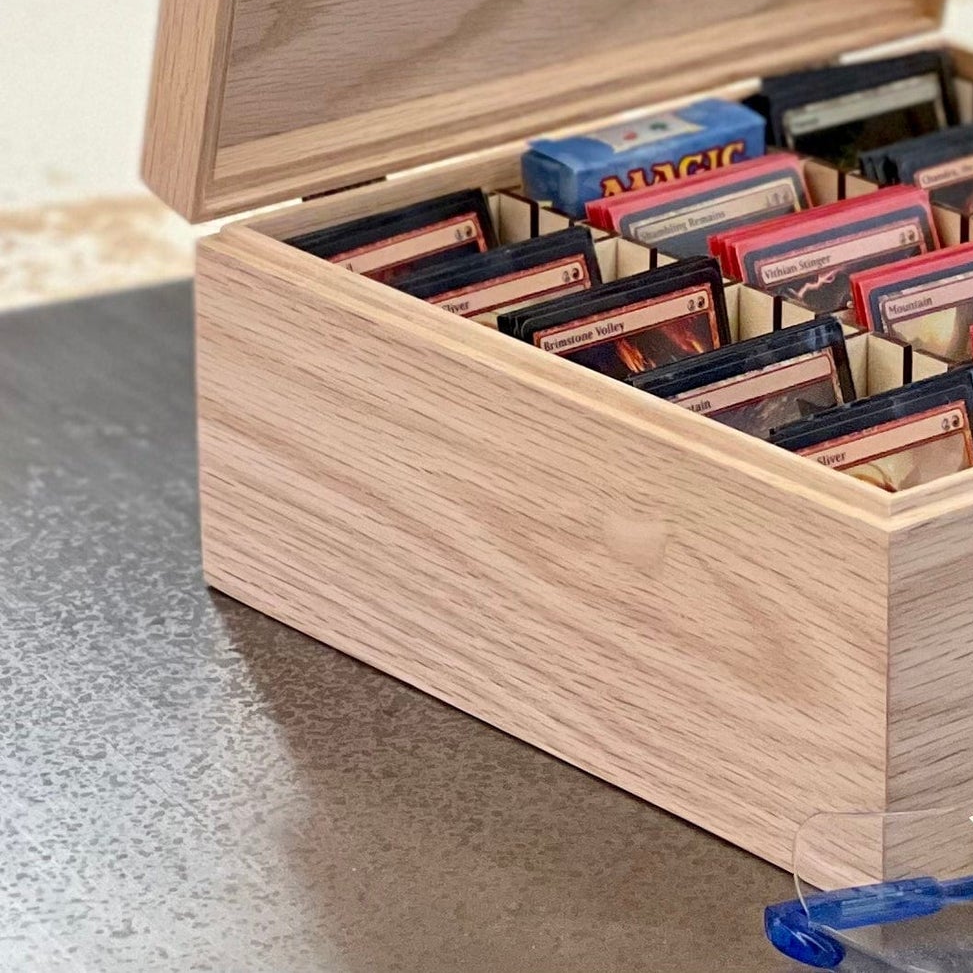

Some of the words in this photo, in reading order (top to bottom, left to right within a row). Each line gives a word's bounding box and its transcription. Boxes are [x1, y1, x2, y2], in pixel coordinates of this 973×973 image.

[601, 141, 746, 198] MAGIC
[688, 210, 726, 228] Remains
[799, 254, 832, 271] Stinger
[888, 297, 933, 315] Mountain
[543, 331, 593, 352] Brimstone
[596, 321, 625, 337] Volley
[686, 399, 711, 413] tain
[817, 451, 847, 466] Sliver
